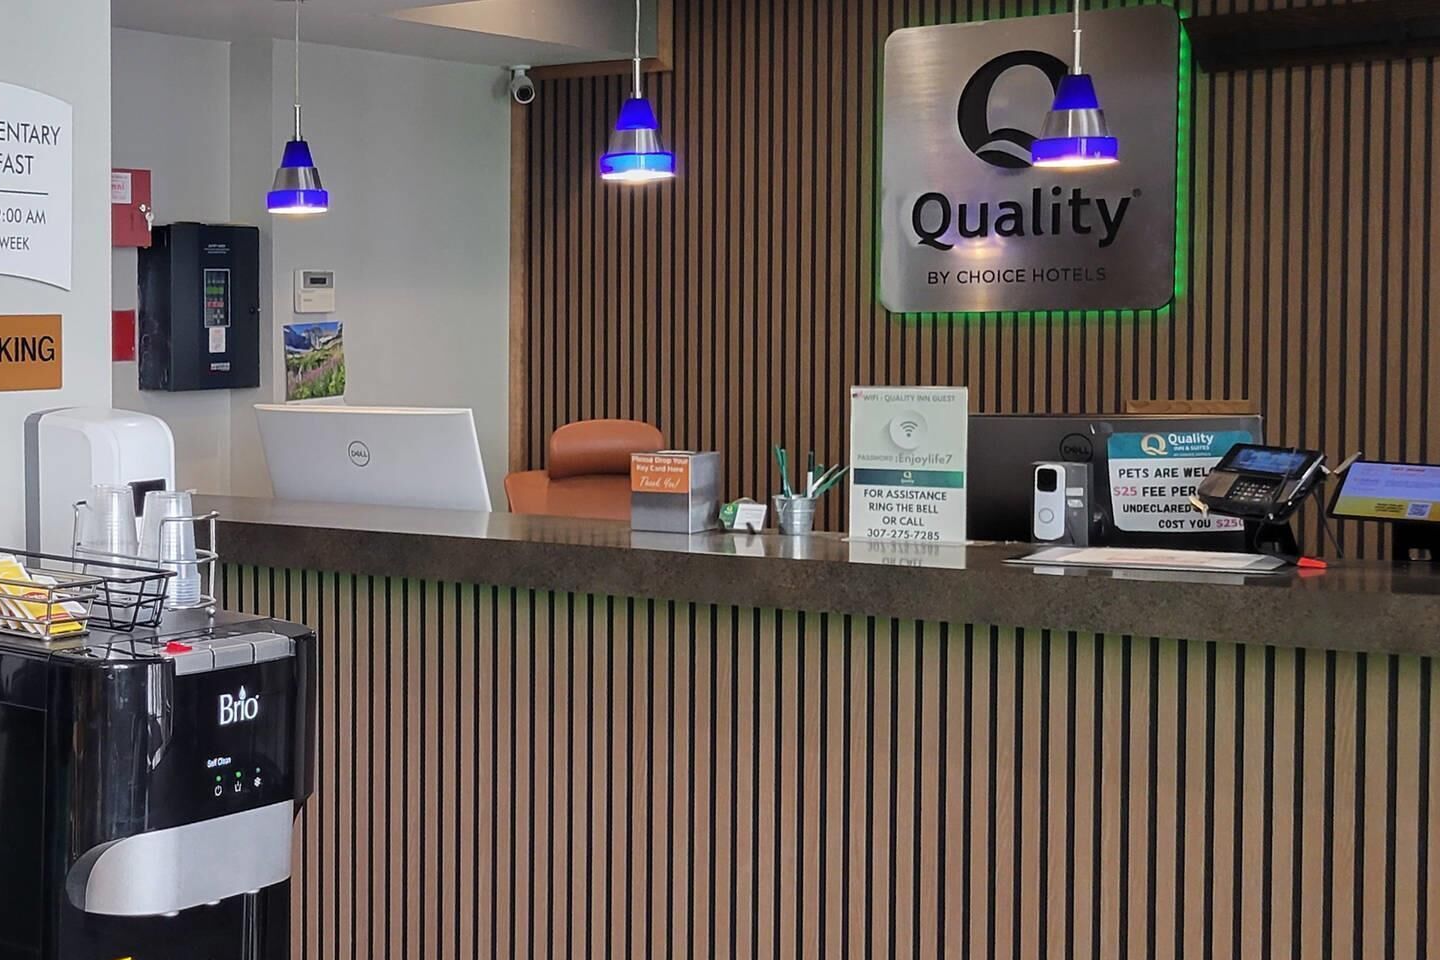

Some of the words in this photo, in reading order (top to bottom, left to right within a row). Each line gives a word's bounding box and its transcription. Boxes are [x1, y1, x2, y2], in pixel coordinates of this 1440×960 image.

[26, 209, 46, 224] AM
[911, 186, 1131, 250] Quality
[928, 271, 950, 285] BY
[957, 269, 1026, 284] CHOICE
[1033, 267, 1106, 283] HOTELS
[1168, 433, 1214, 446] Quality
[1118, 468, 1149, 478] PETS
[1154, 468, 1179, 478] ARE
[864, 489, 883, 498] FOR
[886, 490, 947, 500] ASSISTANCE
[1142, 486, 1166, 497] FEE
[1171, 486, 1197, 497] PER
[868, 502, 893, 511] RING
[896, 503, 914, 512] THE
[916, 504, 938, 514] BELL
[1122, 504, 1191, 513] UNDECLARED
[882, 516, 896, 525] OR
[899, 517, 925, 526] CALL
[1158, 520, 1184, 529] COST
[1189, 520, 1211, 529] YOU
[867, 528, 940, 540] 307-275-7285
[220, 686, 258, 725] Brio
